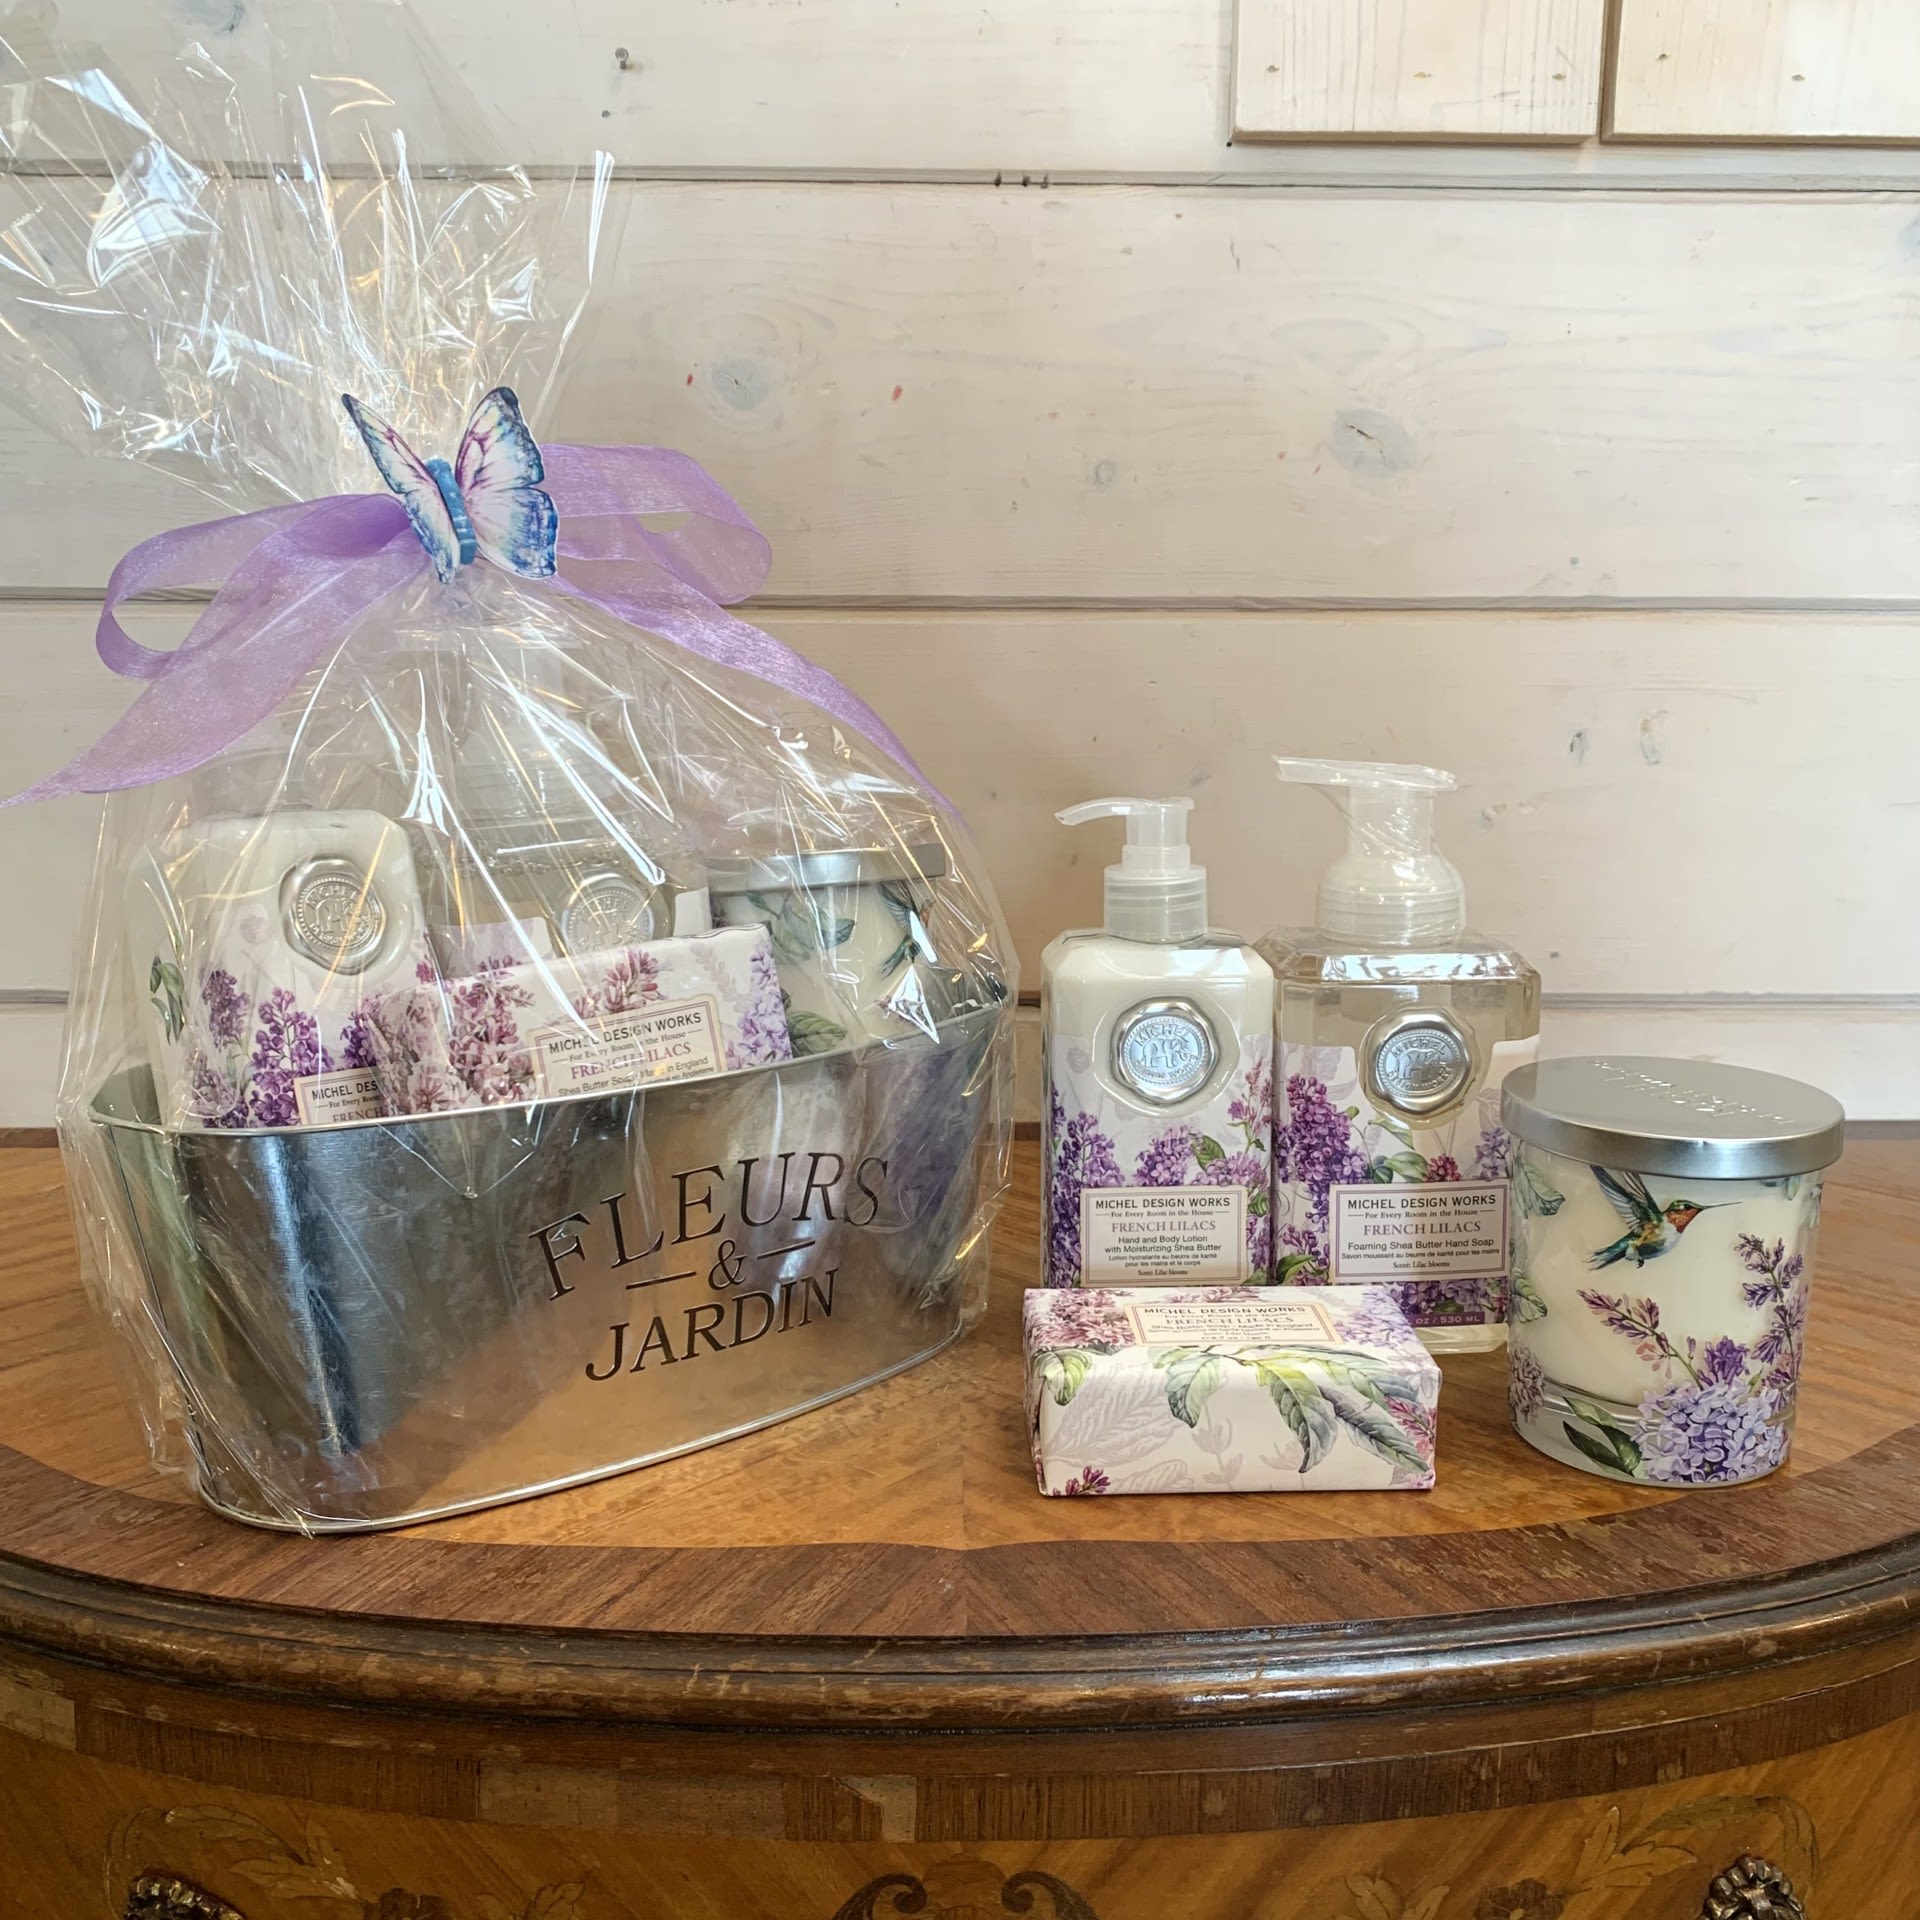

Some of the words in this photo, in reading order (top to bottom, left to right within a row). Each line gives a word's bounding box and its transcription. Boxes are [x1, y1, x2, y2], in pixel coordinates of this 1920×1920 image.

[603, 1022, 652, 1042] DESIGN
[655, 1012, 702, 1031] WORKS
[611, 1044, 634, 1052] Room
[661, 1032, 686, 1041] House
[559, 1087, 581, 1097] Shea
[583, 1081, 609, 1091] Butter
[676, 1056, 708, 1070] England
[312, 1085, 353, 1100] MICHEL
[1096, 1199, 1138, 1209] MICHEL
[1143, 1198, 1184, 1208] DESIGN
[1189, 1197, 1230, 1207] WORKS
[1348, 1199, 1396, 1209] MICHEL
[1400, 1197, 1447, 1208] DESIGN
[1452, 1194, 1496, 1206] WORKS
[1125, 1210, 1144, 1218] Every
[1380, 1211, 1402, 1219] Every
[1454, 1208, 1478, 1216] House
[529, 1152, 888, 1300] FLEURS
[1112, 1221, 1166, 1232] FRENCH
[1170, 1220, 1216, 1231] LILACS
[1363, 1223, 1425, 1236] FRENCH
[1430, 1221, 1481, 1234] LILACS
[1118, 1236, 1140, 1244] Hand
[1160, 1235, 1180, 1244] Body
[1348, 1242, 1387, 1252] Foaming
[1390, 1241, 1412, 1250] Shea
[1415, 1240, 1442, 1249] Butter
[1445, 1239, 1469, 1247] Hand
[1471, 1238, 1494, 1247] Soap
[1105, 1245, 1121, 1253] with
[1124, 1244, 1172, 1253] Moisturizing
[1174, 1243, 1195, 1251] Shea
[1197, 1243, 1221, 1251] Butter
[708, 1239, 746, 1290] &
[585, 1268, 838, 1382] JARDIN
[1440, 1315, 1462, 1324] 530
